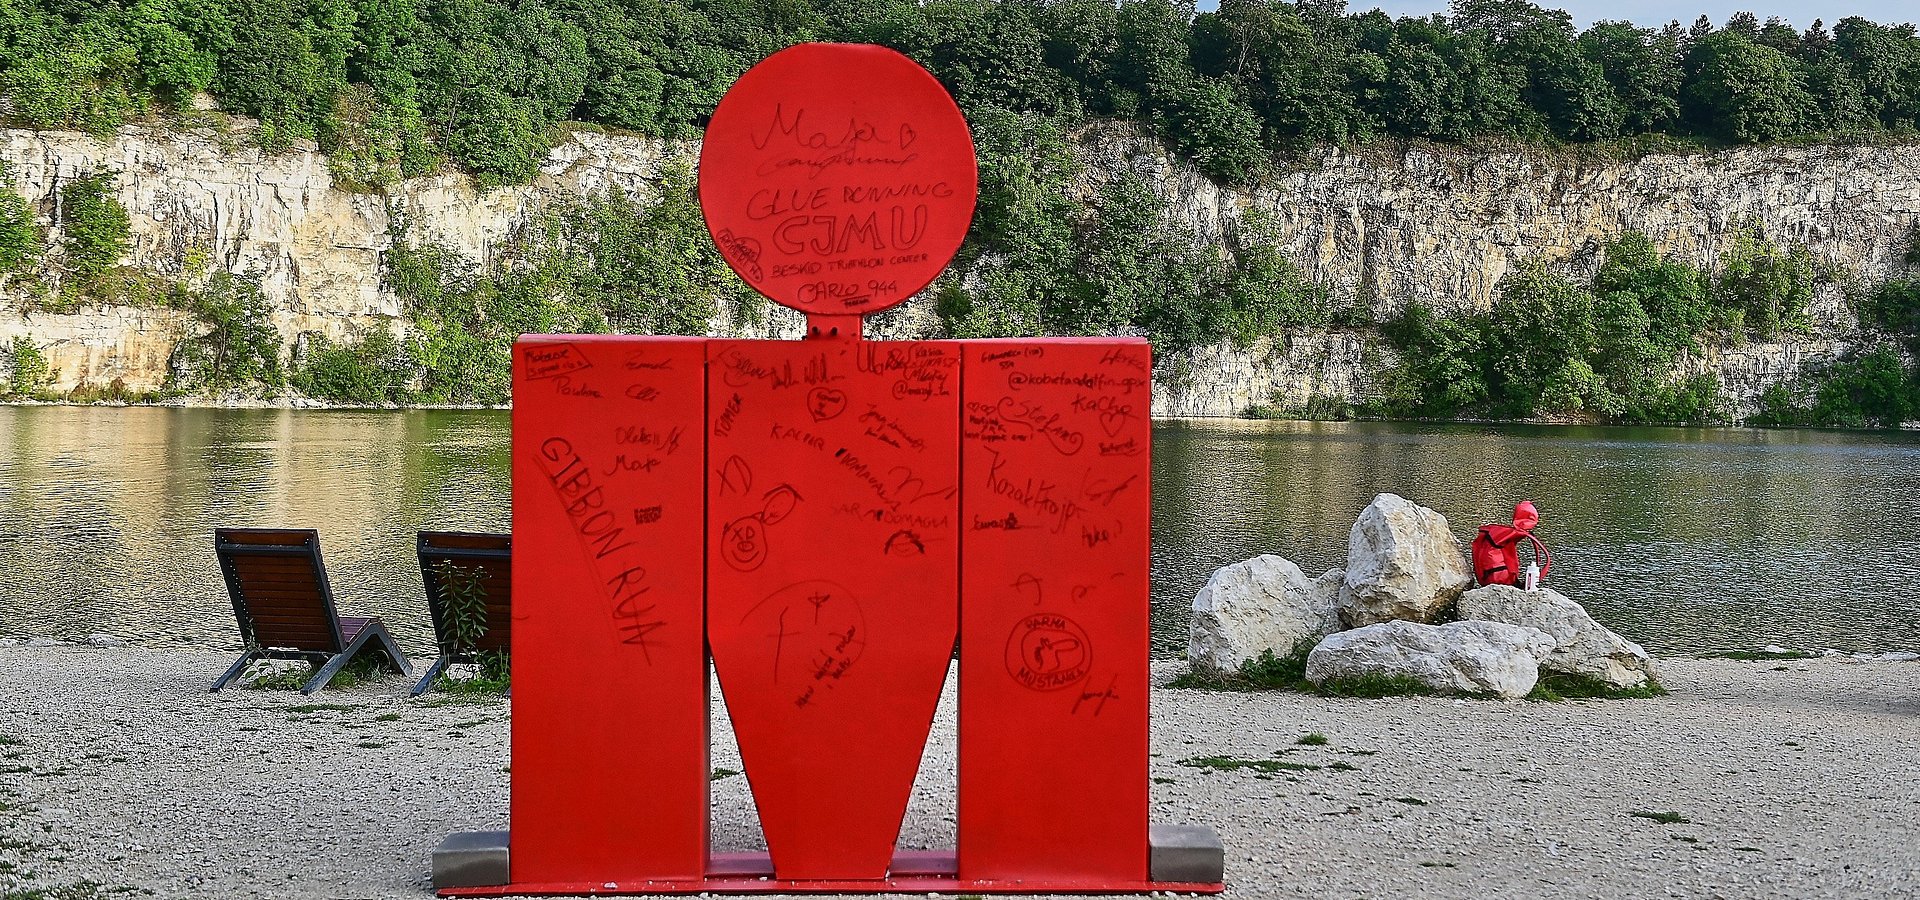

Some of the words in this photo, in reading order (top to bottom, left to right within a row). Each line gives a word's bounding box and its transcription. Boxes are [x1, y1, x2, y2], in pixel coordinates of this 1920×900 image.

[746, 187, 830, 220] GLUE
[769, 262, 822, 279] BESKID
[797, 280, 860, 304] CARLO
[867, 279, 898, 298] 944
[541, 437, 639, 560] GIBBON
[606, 566, 671, 646] RUN
